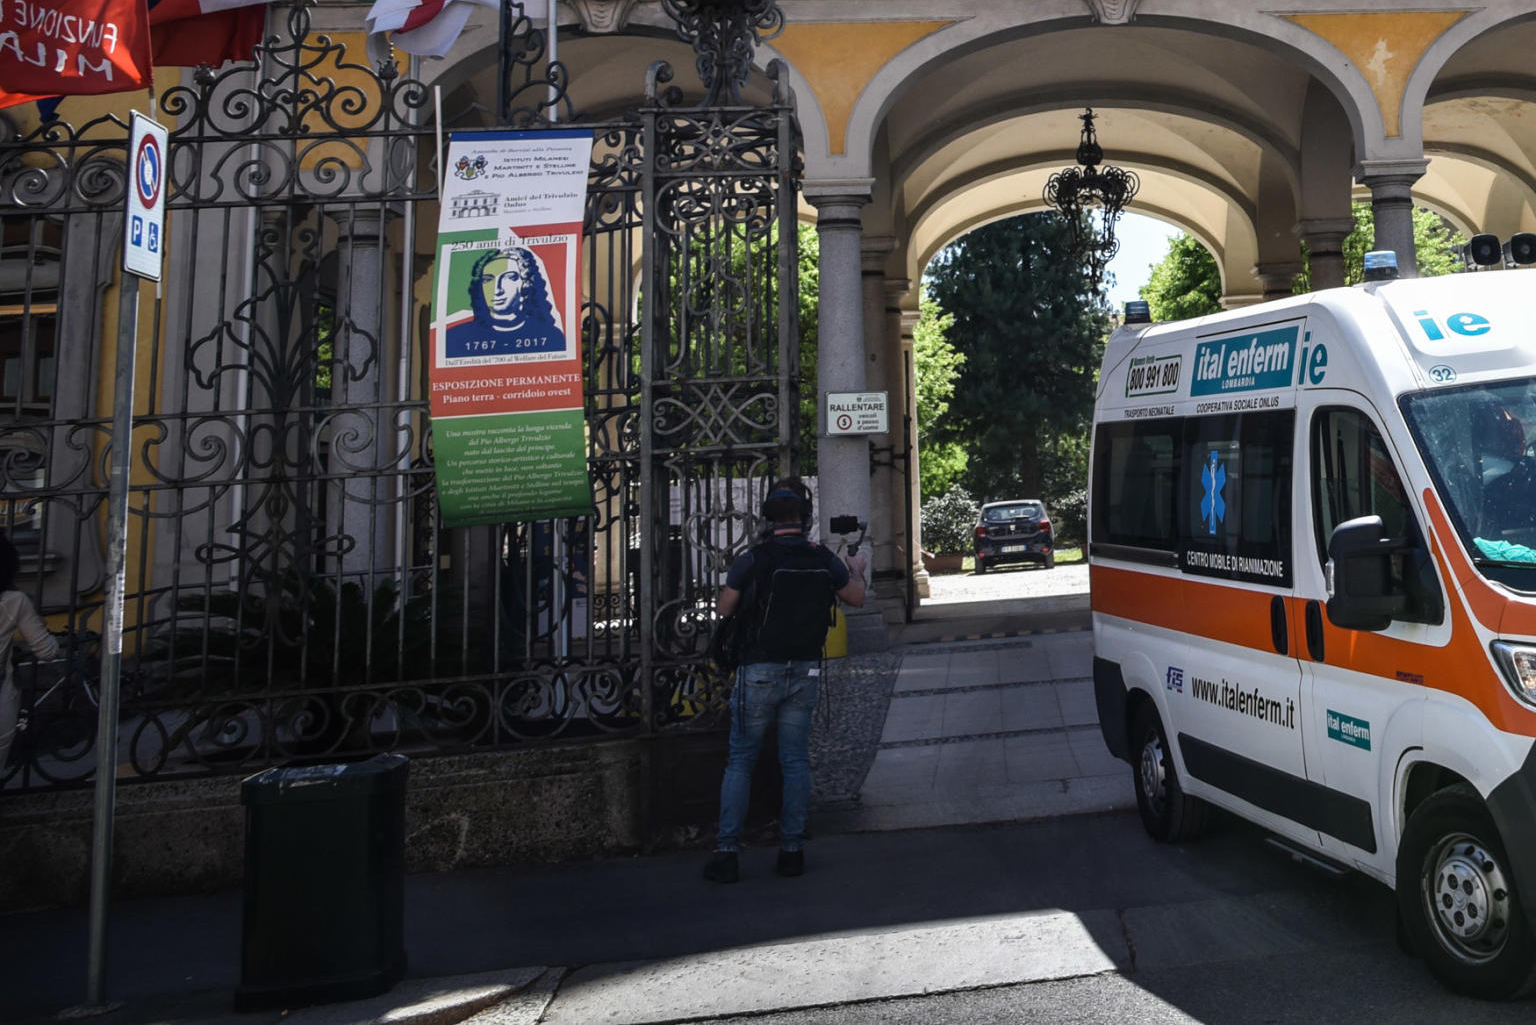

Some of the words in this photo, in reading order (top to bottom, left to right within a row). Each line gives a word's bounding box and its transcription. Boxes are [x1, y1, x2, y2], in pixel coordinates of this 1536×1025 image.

[451, 241, 473, 251] 250
[476, 240, 500, 248] anni
[505, 237, 515, 246] di
[521, 234, 568, 245] Trivulzio
[465, 341, 496, 350] 1767
[516, 337, 547, 347] 2017
[1197, 344, 1226, 381] ital
[1228, 337, 1290, 377] enferm
[433, 378, 504, 391] ESPOSIZIONE
[506, 374, 580, 386] PERMANENTE
[1130, 367, 1144, 390] 800
[1146, 365, 1161, 388] 991
[1162, 362, 1179, 386] 800
[1222, 377, 1255, 389] LOMBARDIA
[1432, 368, 1453, 383] 32
[443, 395, 470, 403] Piano
[503, 389, 546, 400] corridoio
[548, 388, 571, 396] ovest
[830, 403, 884, 411] RALLENTARE
[1149, 406, 1175, 416] NEONATALE
[1197, 401, 1234, 413] COOPERATIVA
[1234, 399, 1258, 410] SOCIALE
[1259, 397, 1280, 408] ONLUS
[1187, 551, 1208, 567] CENTRO
[1210, 554, 1231, 570] MOBILE
[1232, 556, 1238, 571] DI
[1239, 557, 1283, 577] RIANIMAZIONE
[1191, 676, 1295, 729] www.italenferm.it
[1341, 721, 1369, 740] enferm
